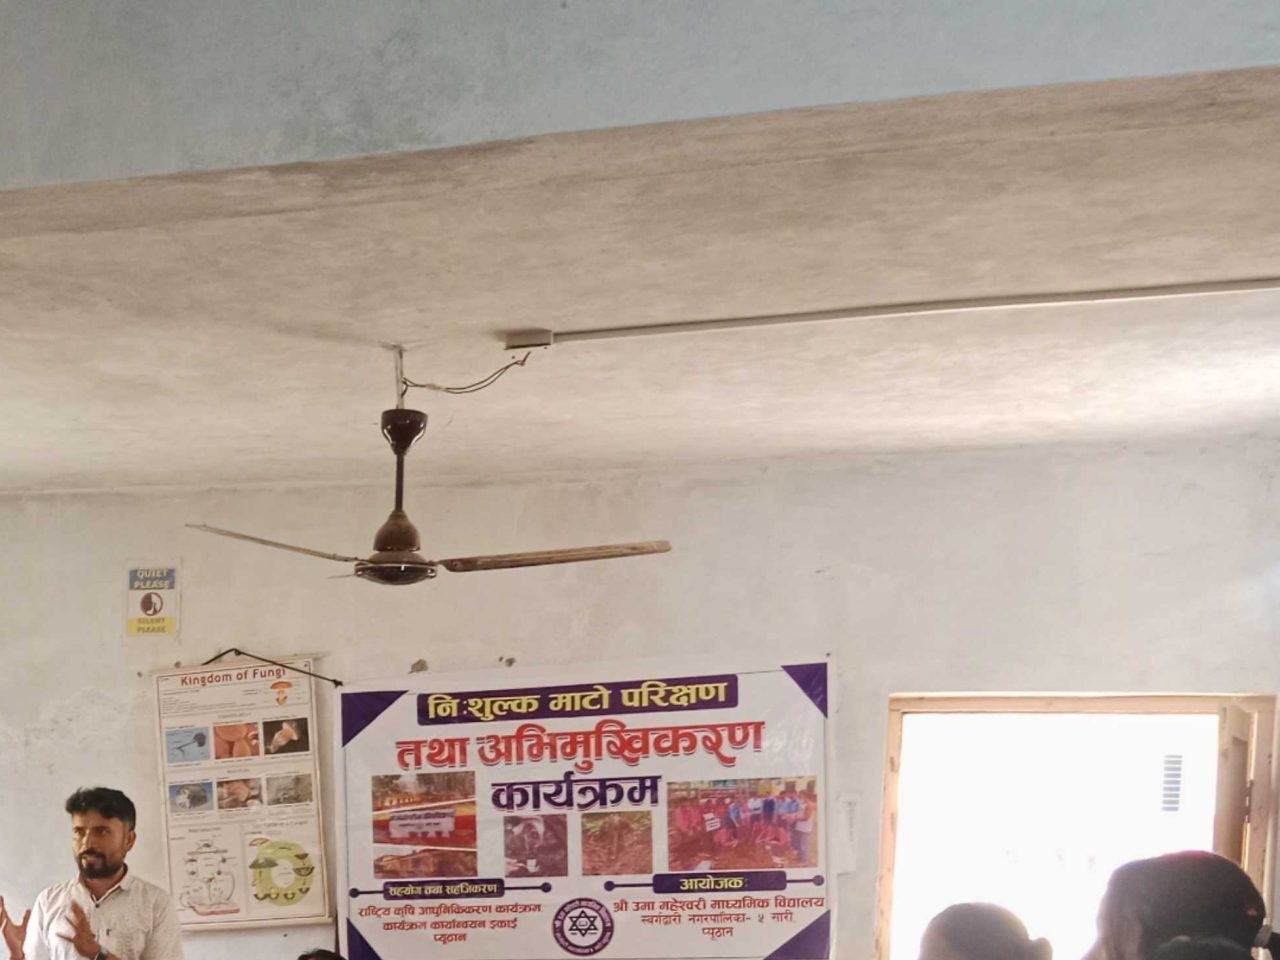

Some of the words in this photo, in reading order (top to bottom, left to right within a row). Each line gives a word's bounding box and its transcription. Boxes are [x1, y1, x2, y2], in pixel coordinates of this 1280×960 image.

[137, 569, 167, 578] QUIET
[134, 580, 169, 589] PLEASE
[181, 673, 232, 687] Kingdom
[237, 670, 249, 681] of
[253, 667, 286, 680] Fungi
[549, 686, 611, 712] माटो
[621, 680, 728, 708] परिक्षण
[396, 737, 470, 770] तथा
[476, 719, 766, 776] अभिमुखिकरण
[490, 771, 662, 814] कार्यक्रम
[496, 903, 542, 914] कार्यक्रम
[613, 898, 628, 912] श्री
[632, 901, 655, 911] उमा
[659, 898, 706, 912] महेश्वरी
[711, 896, 771, 909] माध्यमिक
[774, 895, 825, 908] विद्यालय
[383, 920, 426, 931] कार्यक्रम
